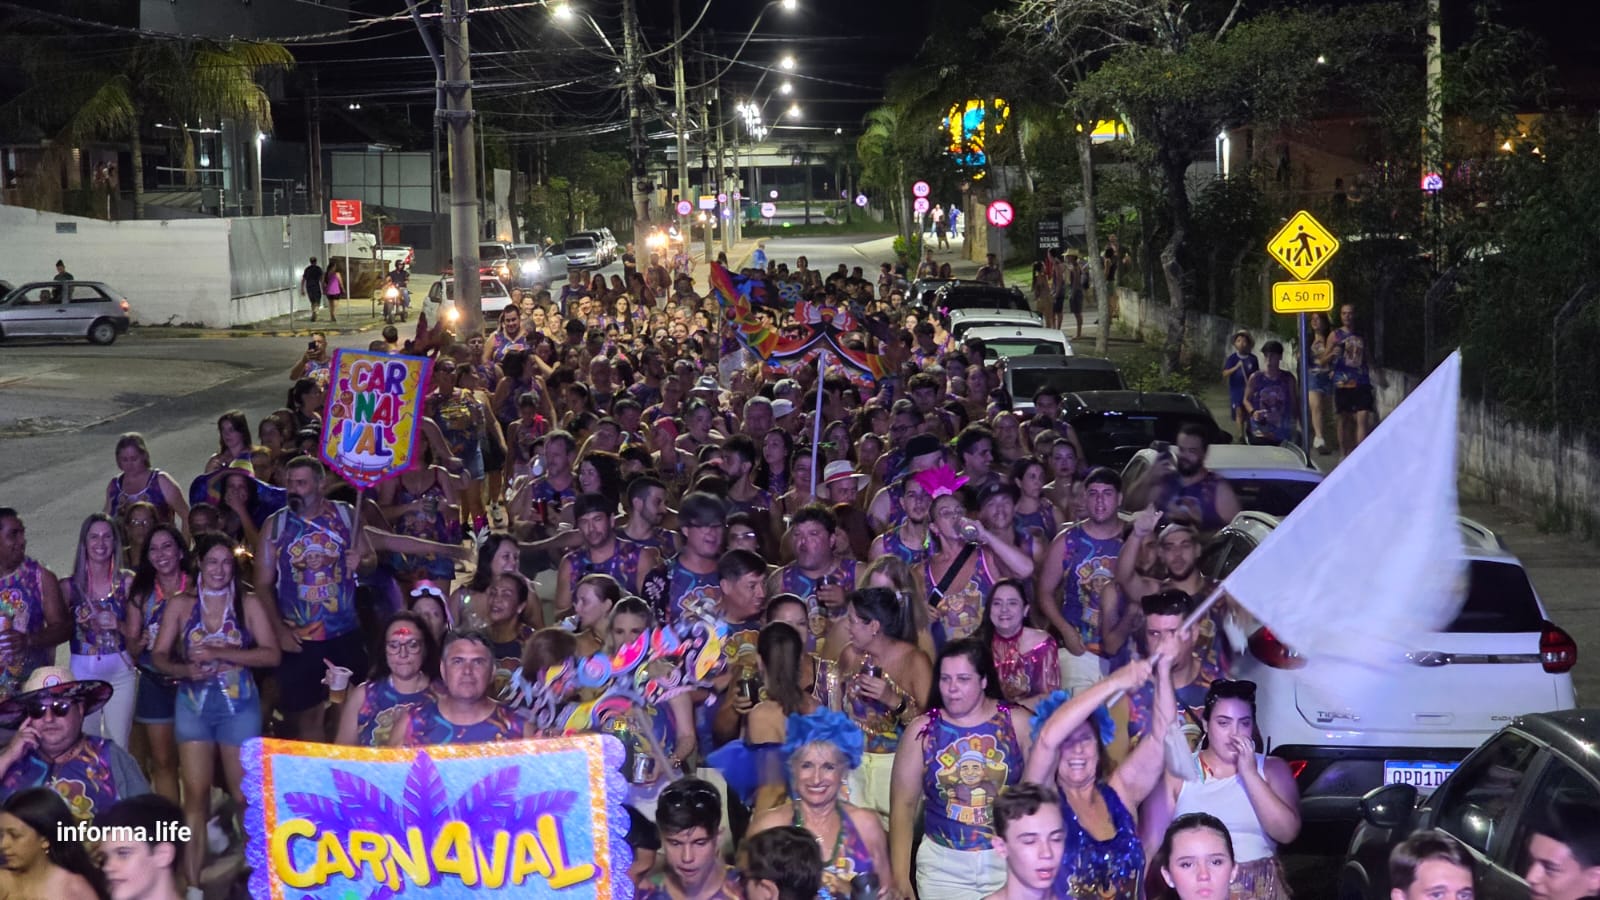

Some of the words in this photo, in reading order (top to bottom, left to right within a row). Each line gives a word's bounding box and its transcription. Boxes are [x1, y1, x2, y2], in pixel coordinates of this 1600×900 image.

[1282, 292, 1291, 302] A
[1295, 291, 1309, 302] 50
[1313, 292, 1325, 301] m
[351, 361, 407, 395] CAR
[354, 392, 393, 427] NA
[343, 419, 393, 456] VAL
[271, 813, 596, 892] CARNAVAL
